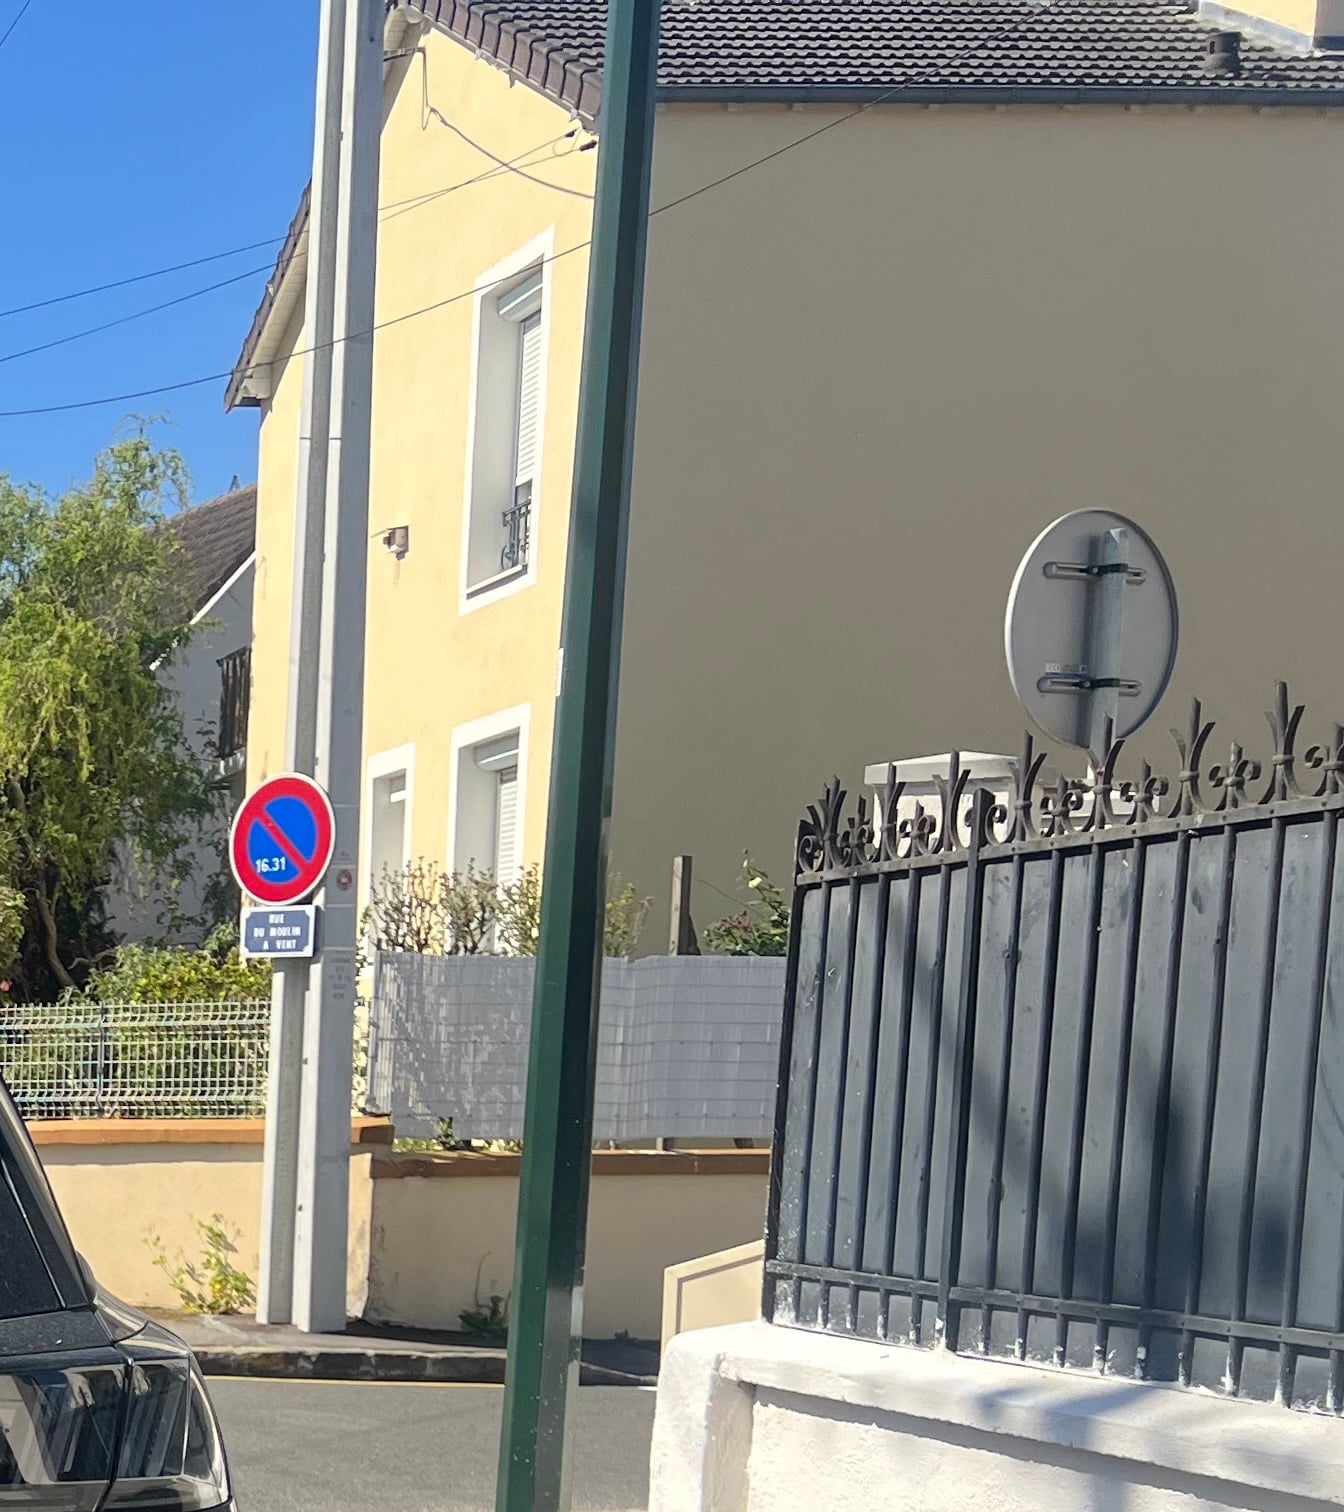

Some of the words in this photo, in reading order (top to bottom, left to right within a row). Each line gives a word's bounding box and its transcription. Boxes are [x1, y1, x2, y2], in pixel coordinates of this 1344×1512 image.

[255, 856, 286, 873] 16.31
[269, 914, 285, 924] RUE
[253, 927, 265, 938] DU
[269, 926, 301, 937] MOULIN
[263, 940, 270, 950] A
[275, 939, 297, 949] VENT
